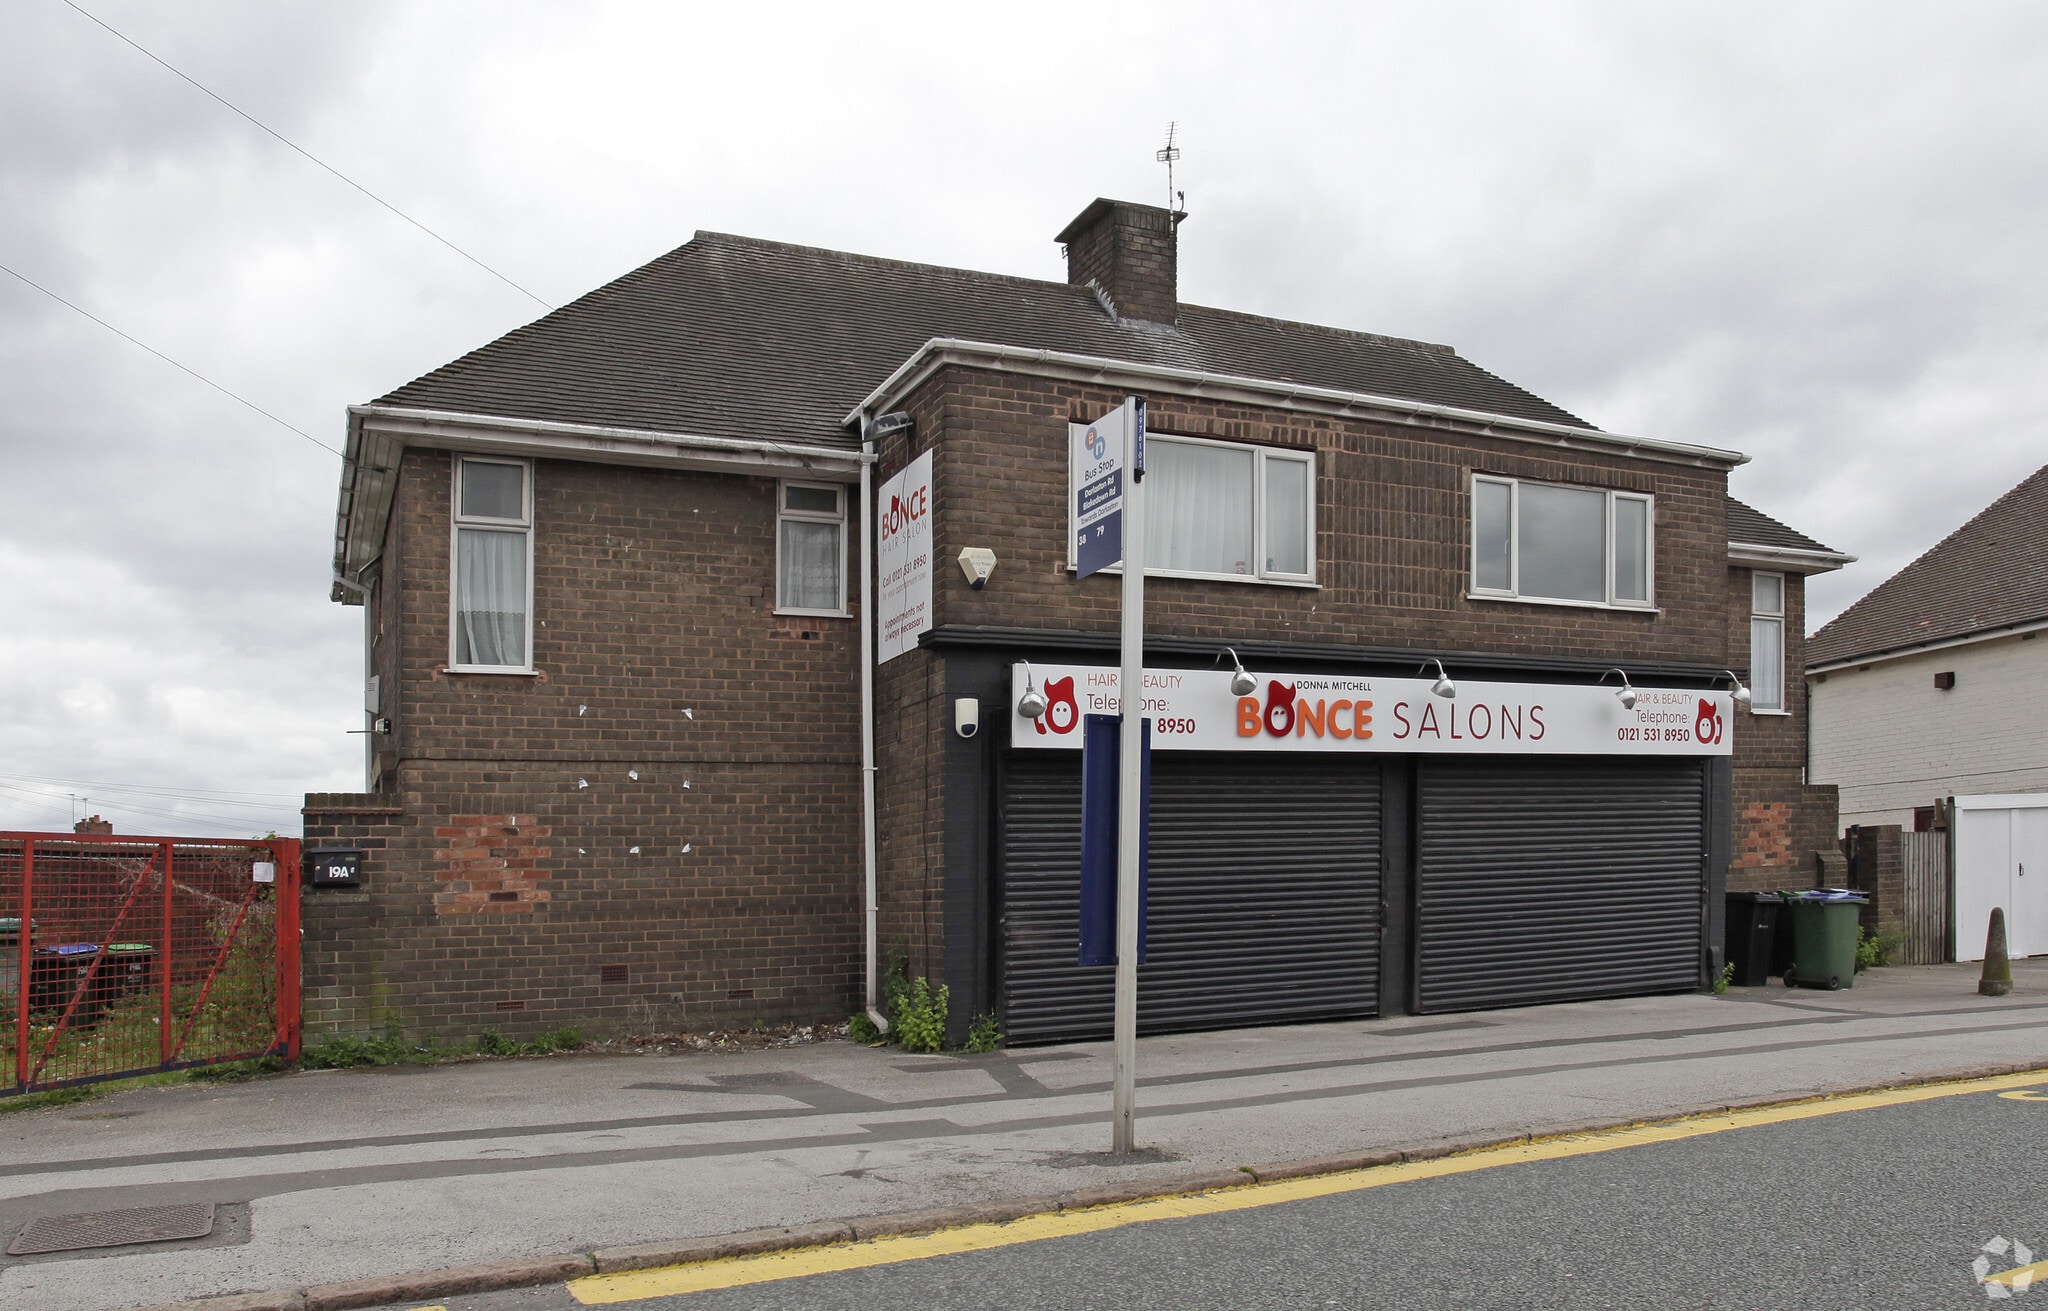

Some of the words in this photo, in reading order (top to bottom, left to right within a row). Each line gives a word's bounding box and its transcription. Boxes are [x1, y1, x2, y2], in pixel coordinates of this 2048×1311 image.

[1085, 468, 1097, 481] Bus
[1098, 459, 1114, 473] Stop
[1085, 481, 1107, 498] Darlaston
[1107, 475, 1115, 486] Rd
[1109, 486, 1116, 497] Rd
[882, 485, 926, 541] BONCE
[1080, 512, 1098, 525] Towards
[883, 536, 899, 558] HAIR
[902, 518, 926, 544] SALON
[1079, 534, 1087, 546] 38
[1096, 525, 1105, 537] 79
[883, 573, 891, 588] Call
[892, 567, 902, 582] 0121
[903, 562, 912, 576] 531
[913, 553, 927, 570] 8950
[885, 606, 915, 630] Appointments
[916, 600, 924, 613] not
[885, 628, 899, 642] always
[901, 616, 924, 634] necessary
[1087, 673, 1118, 687] HAIR
[1140, 675, 1183, 689] EAUTY
[1296, 680, 1329, 691] DONNA
[1331, 681, 1372, 692] MITCHELL
[1087, 693, 1170, 714] Teleone:
[1653, 694, 1659, 705] &
[1662, 693, 1694, 706] BEAUTY
[1237, 680, 1374, 739] BONCE
[1392, 701, 1546, 741] SALONS
[1635, 709, 1690, 726] Telephone:
[1157, 717, 1196, 734] 8950
[1618, 728, 1640, 741] 0121
[1643, 728, 1661, 742] 531
[1664, 729, 1690, 742] 8950
[329, 866, 349, 878] 19A
